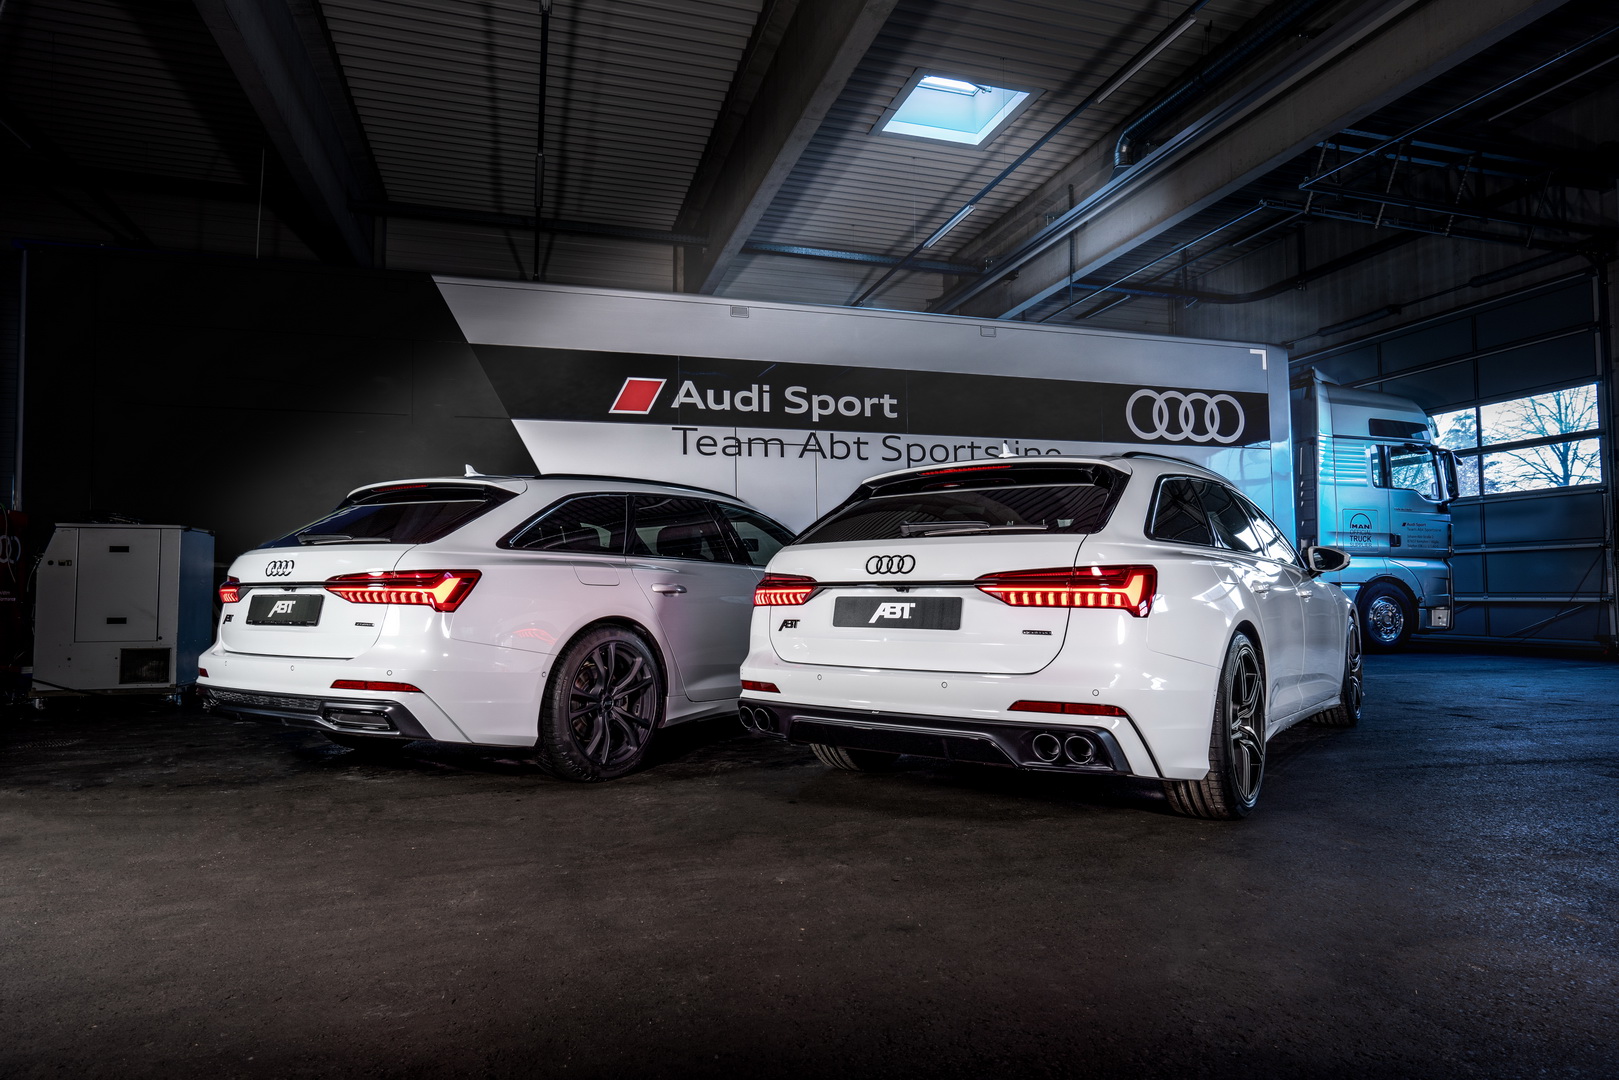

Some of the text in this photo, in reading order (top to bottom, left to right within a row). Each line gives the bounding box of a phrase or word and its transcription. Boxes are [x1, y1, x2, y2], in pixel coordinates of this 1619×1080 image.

[671, 380, 898, 422] Audi Sport
[672, 427, 1061, 468] Team Abt Sportsi
[267, 600, 296, 617] ABT
[868, 602, 916, 623] ABT
[778, 619, 800, 632] ABT
